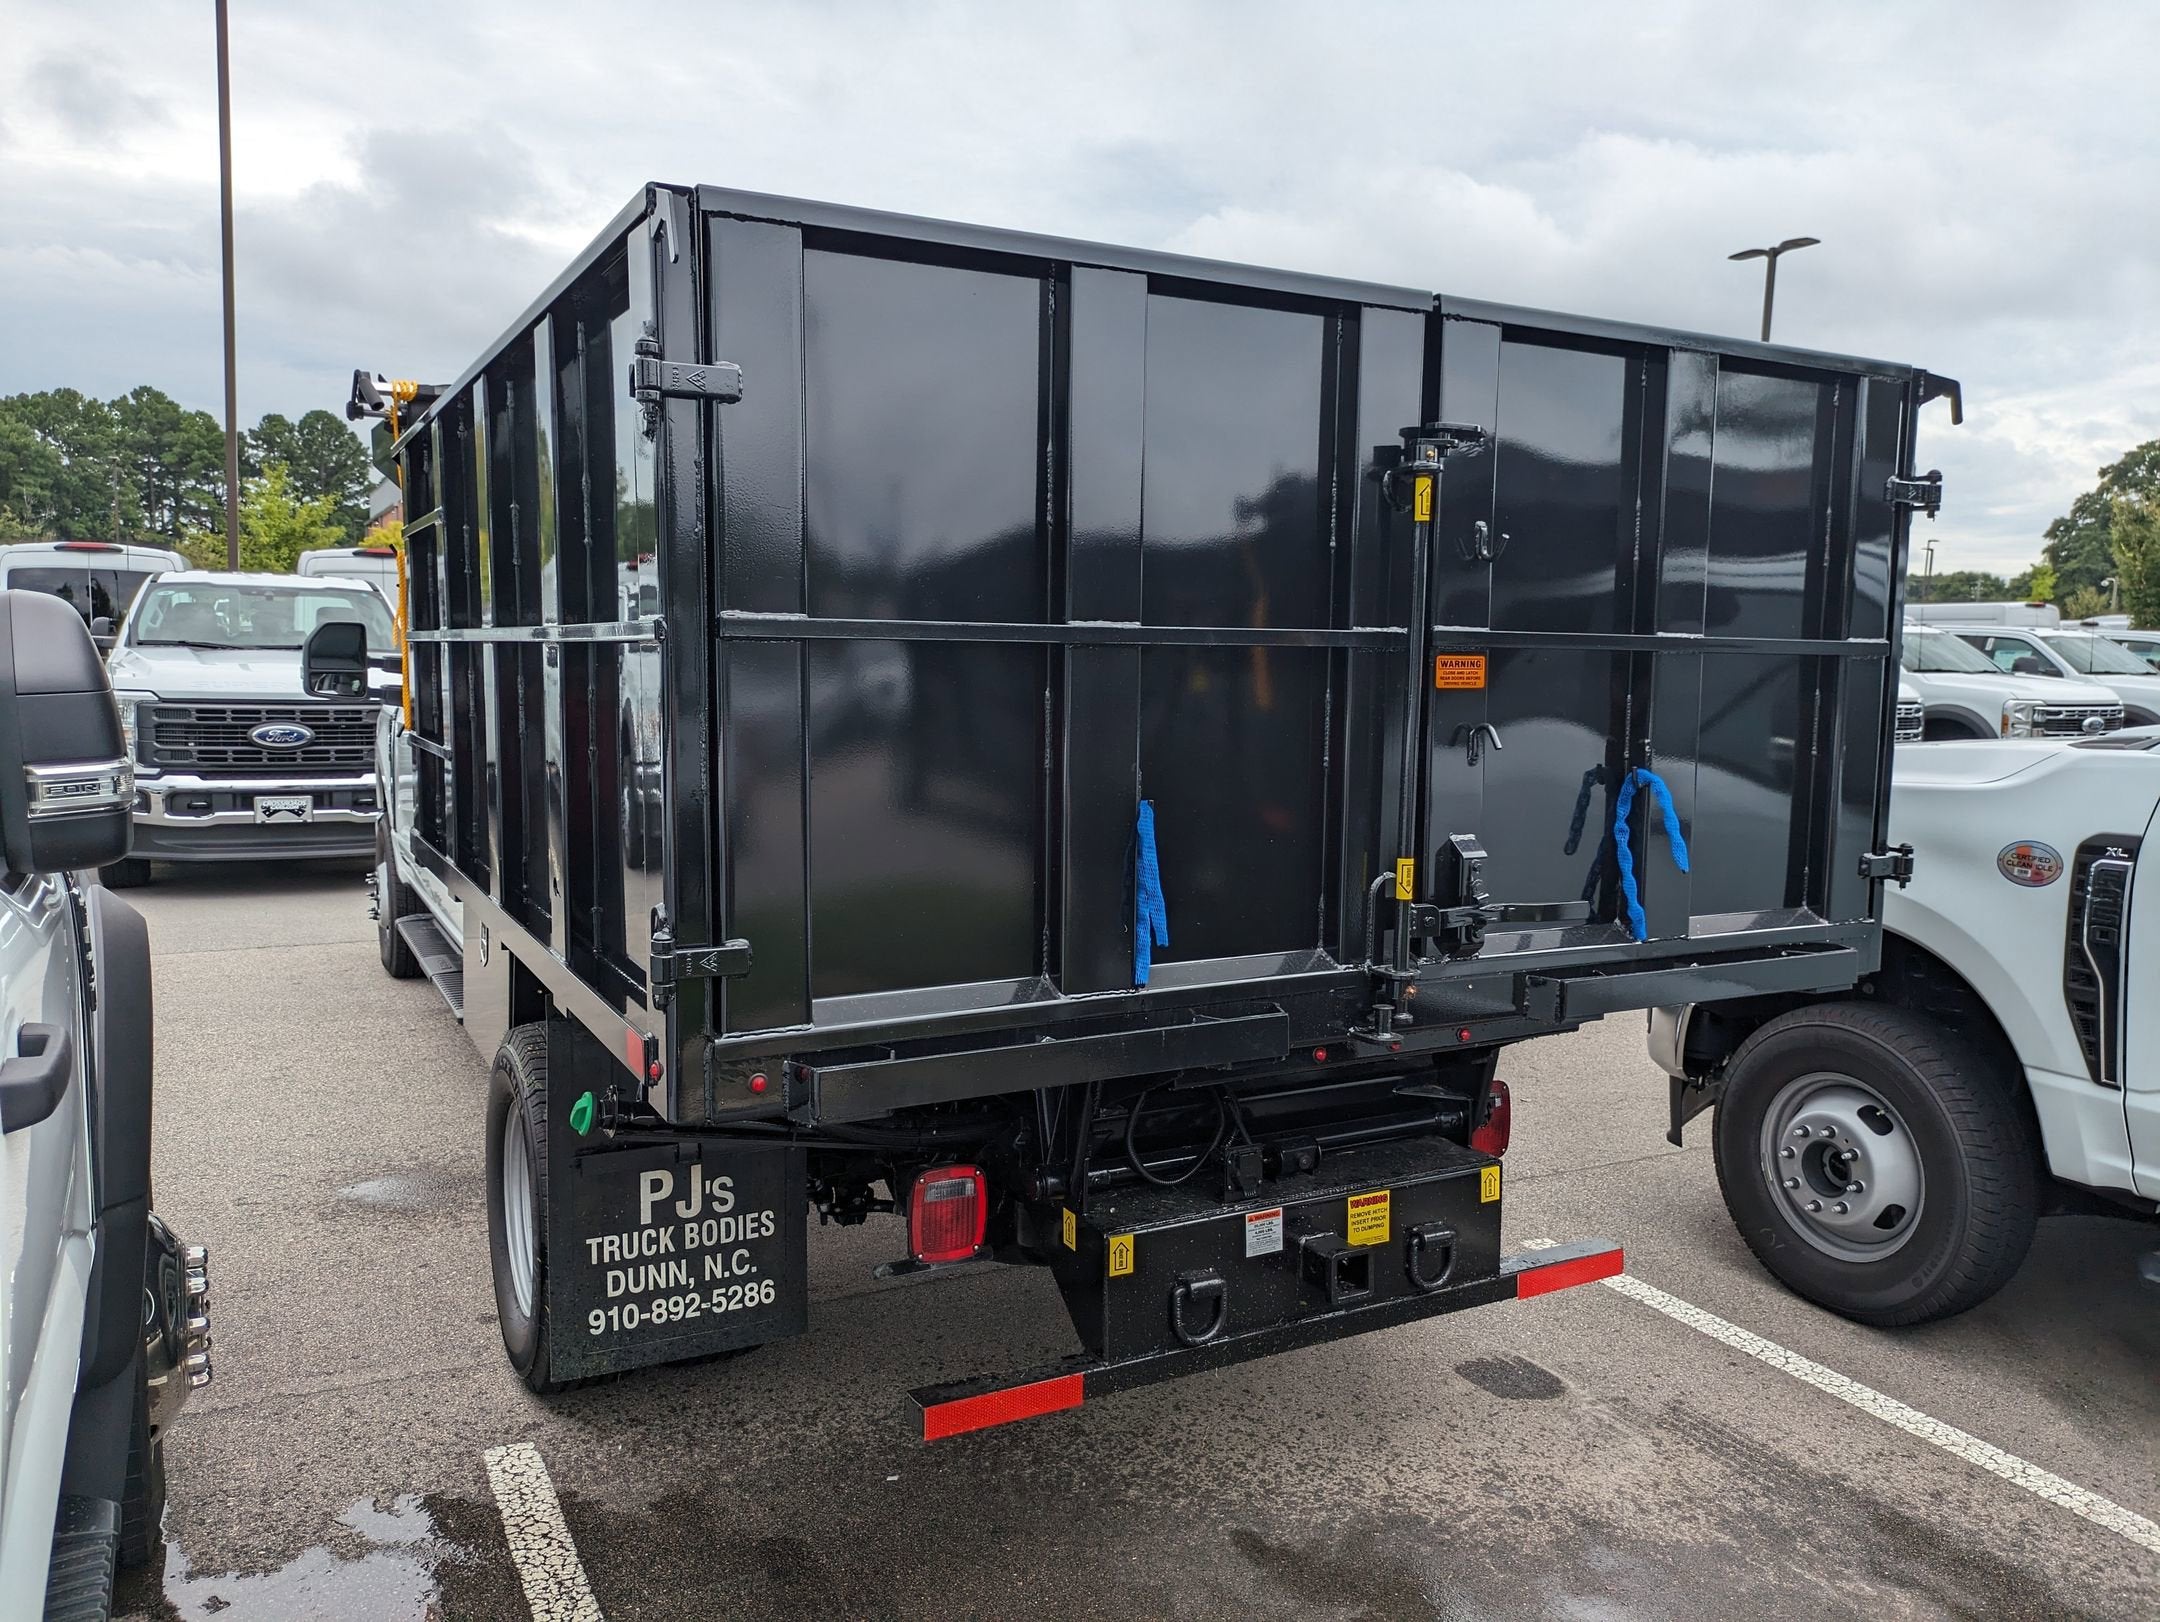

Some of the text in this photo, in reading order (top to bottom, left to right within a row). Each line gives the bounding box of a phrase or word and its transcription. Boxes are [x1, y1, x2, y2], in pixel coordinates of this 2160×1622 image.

[1440, 660, 1481, 668] WARNING
[265, 729, 297, 742] Ford
[2010, 852, 2051, 864] CERTIFIED
[2105, 847, 2129, 858] XL
[2006, 859, 2033, 869] CLEAN
[2035, 863, 2054, 873] IDLE
[1350, 1193, 1388, 1209] WARNING
[1254, 1210, 1281, 1220] WARNING
[1350, 1207, 1388, 1219] REMOVE HITCH
[1350, 1214, 1387, 1226] INSERT PRIOR
[1361, 1222, 1385, 1232] DUMPING
[586, 1210, 775, 1265] TRUCK BODIES
[607, 1248, 757, 1298] DUNN, N.C.
[588, 1279, 775, 1335] 910-892-5286
